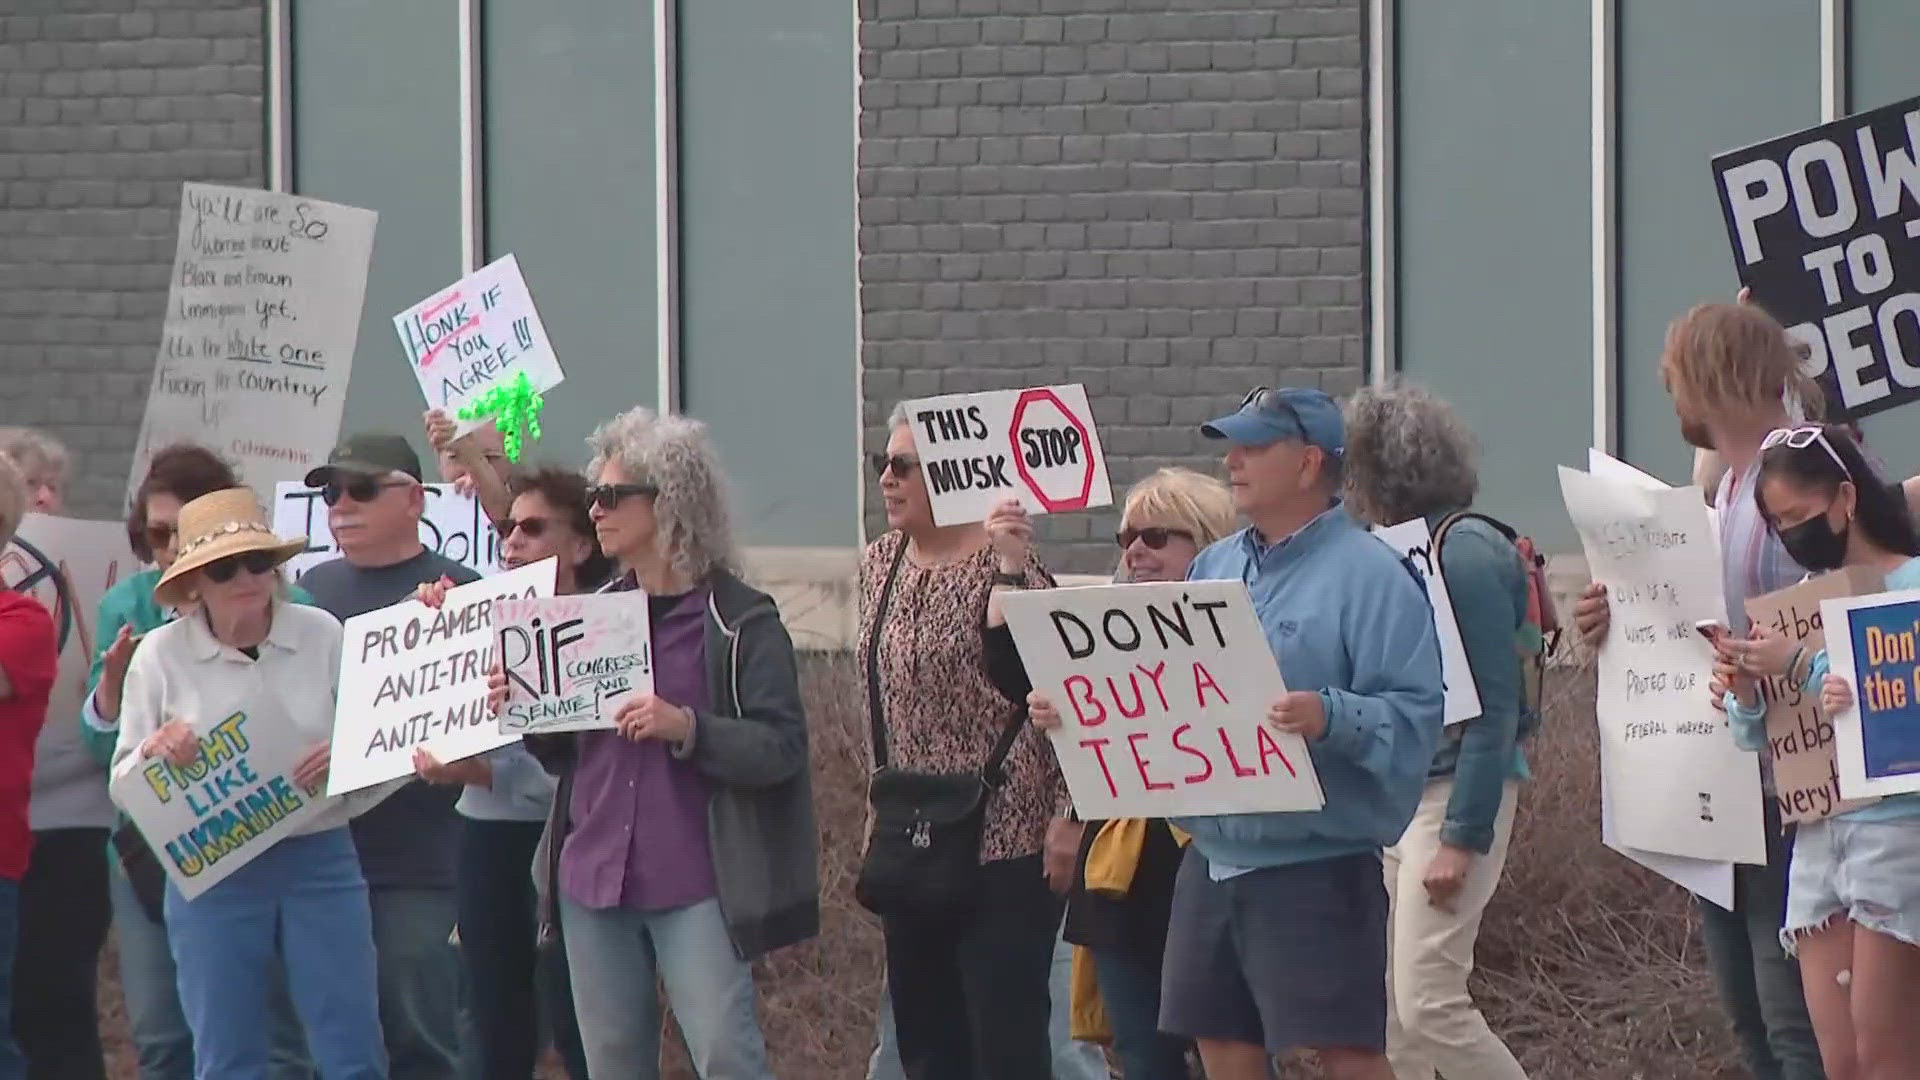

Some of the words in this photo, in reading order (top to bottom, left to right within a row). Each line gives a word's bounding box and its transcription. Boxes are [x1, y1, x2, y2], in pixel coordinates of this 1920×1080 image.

[1802, 233, 1895, 306] TO
[404, 303, 471, 365] HONK
[480, 283, 503, 312] IF
[917, 406, 989, 443] THIS
[1021, 425, 1080, 468] STOP
[927, 455, 1013, 495] MUSK
[1050, 593, 1227, 660] DON'T
[1063, 661, 1170, 728] BUY
[1193, 661, 1230, 708] A
[1864, 673, 1907, 712] the
[186, 759, 257, 817] LIKE
[1080, 723, 1297, 798] TESLA
[165, 775, 304, 877] UKRAINE
